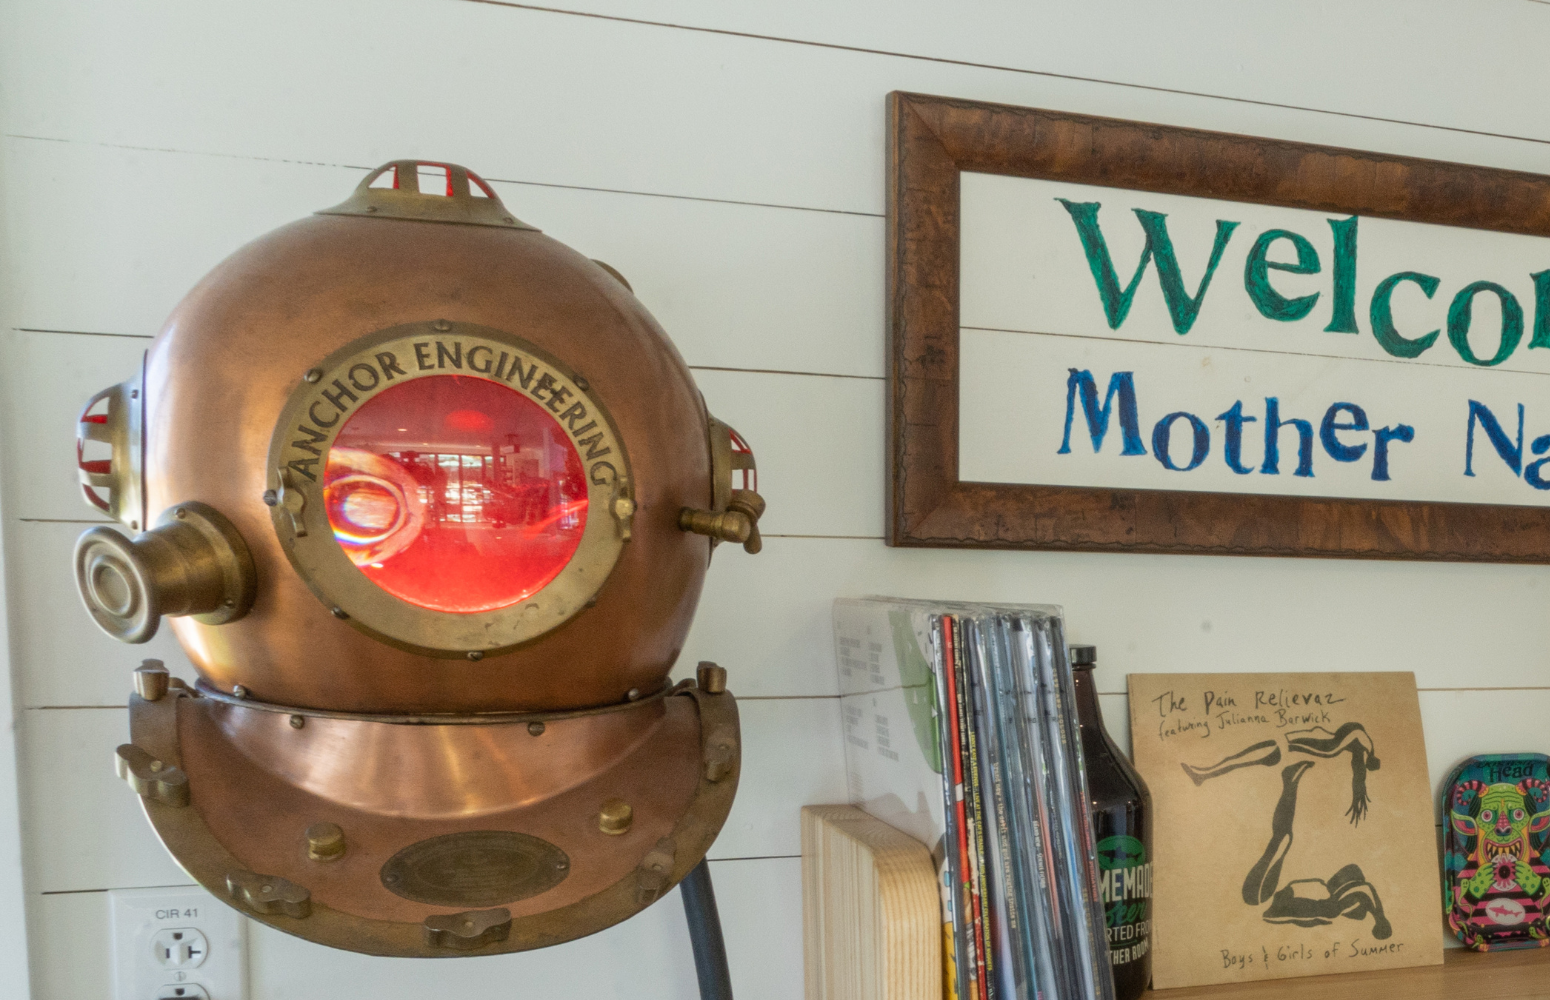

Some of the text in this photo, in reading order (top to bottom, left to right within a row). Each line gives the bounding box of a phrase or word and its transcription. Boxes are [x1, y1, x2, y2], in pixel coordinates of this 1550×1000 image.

[288, 340, 618, 487] ANCHOR ENGINEERING
[1058, 369, 1415, 483] Mother
[1152, 691, 1188, 717] The
[1204, 690, 1237, 716] Pain
[1158, 719, 1211, 742] featuring
[1216, 710, 1271, 730] Julianna
[1489, 763, 1534, 783] Head
[1099, 861, 1153, 903] MEMAD
[155, 908, 198, 920] CIR 41
[1106, 925, 1134, 942] RTED
[1110, 948, 1130, 965] HER
[1220, 948, 1254, 970] Boys
[1276, 943, 1314, 962] Girls
[1324, 941, 1341, 959] of
